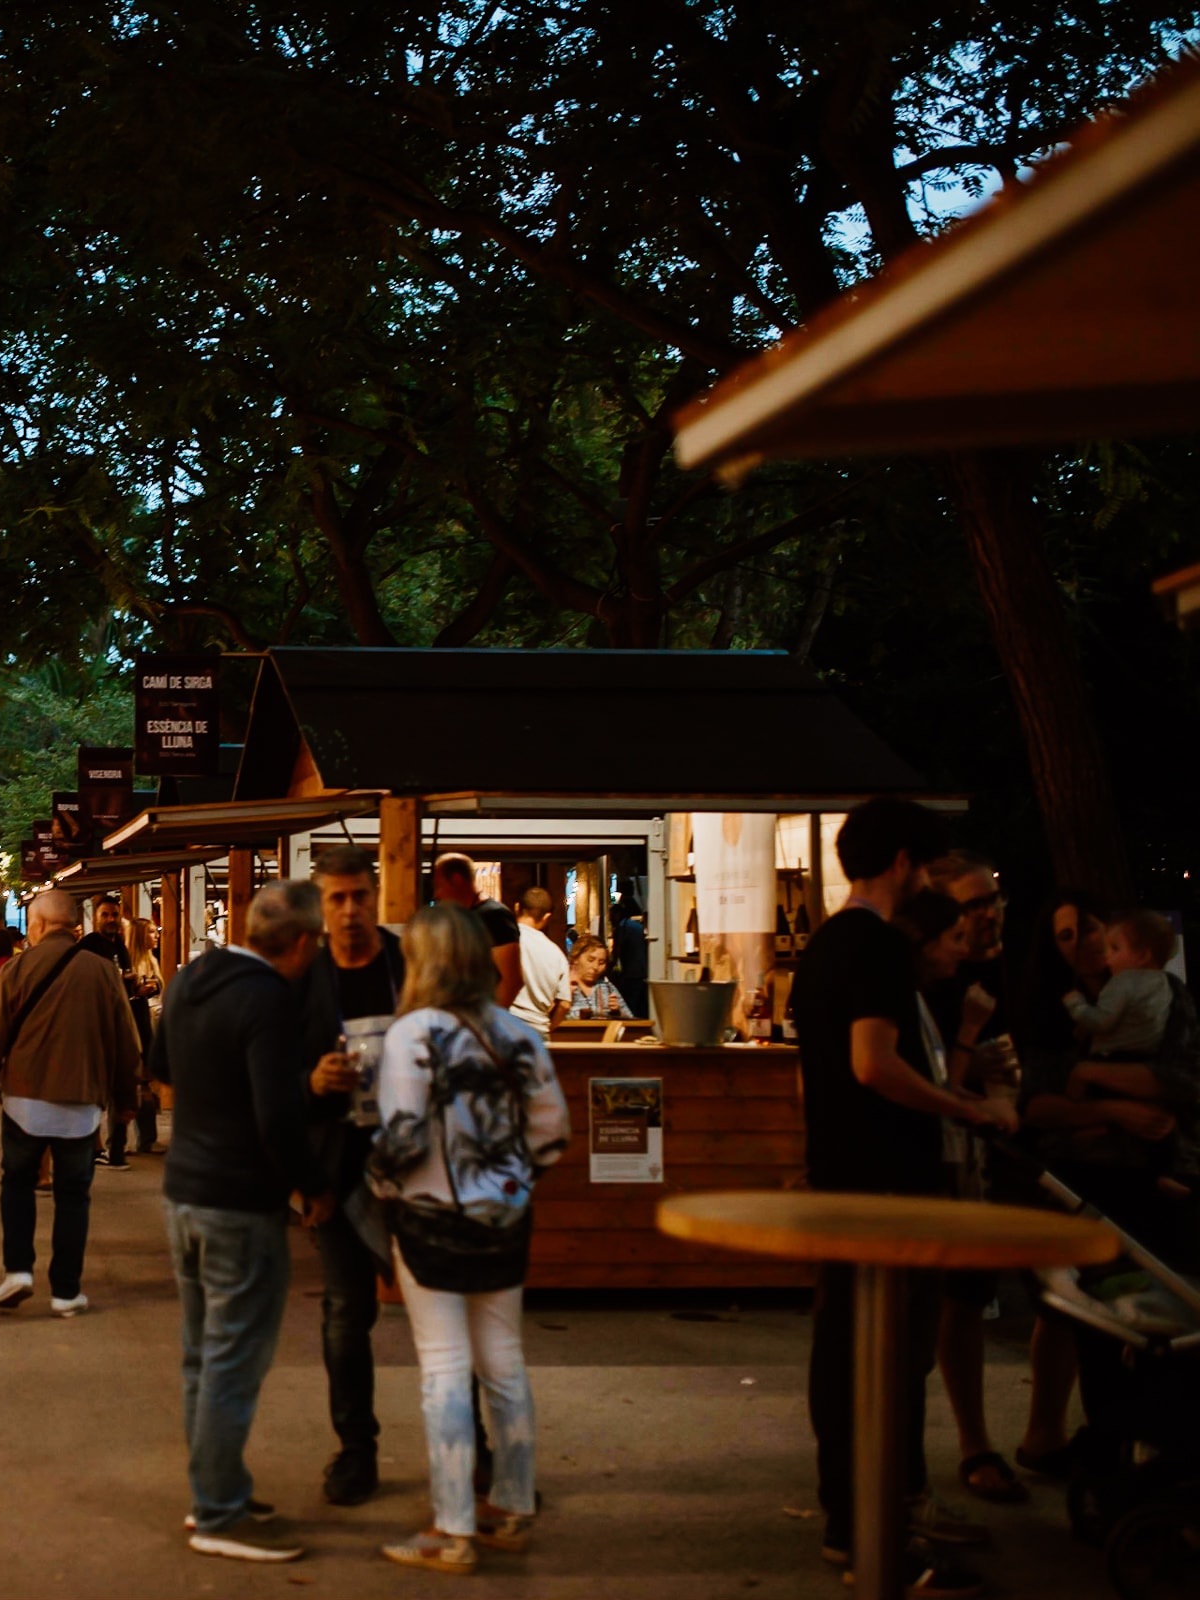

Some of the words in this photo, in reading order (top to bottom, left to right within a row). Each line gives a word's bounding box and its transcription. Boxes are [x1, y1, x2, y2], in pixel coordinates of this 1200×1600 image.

[142, 674, 168, 689] CAMÍ
[169, 676, 182, 689] DE
[184, 676, 213, 689] SIRGA
[147, 718, 193, 733] ESSÈNCIA
[195, 721, 208, 733] DE
[162, 736, 193, 748] LLUNA
